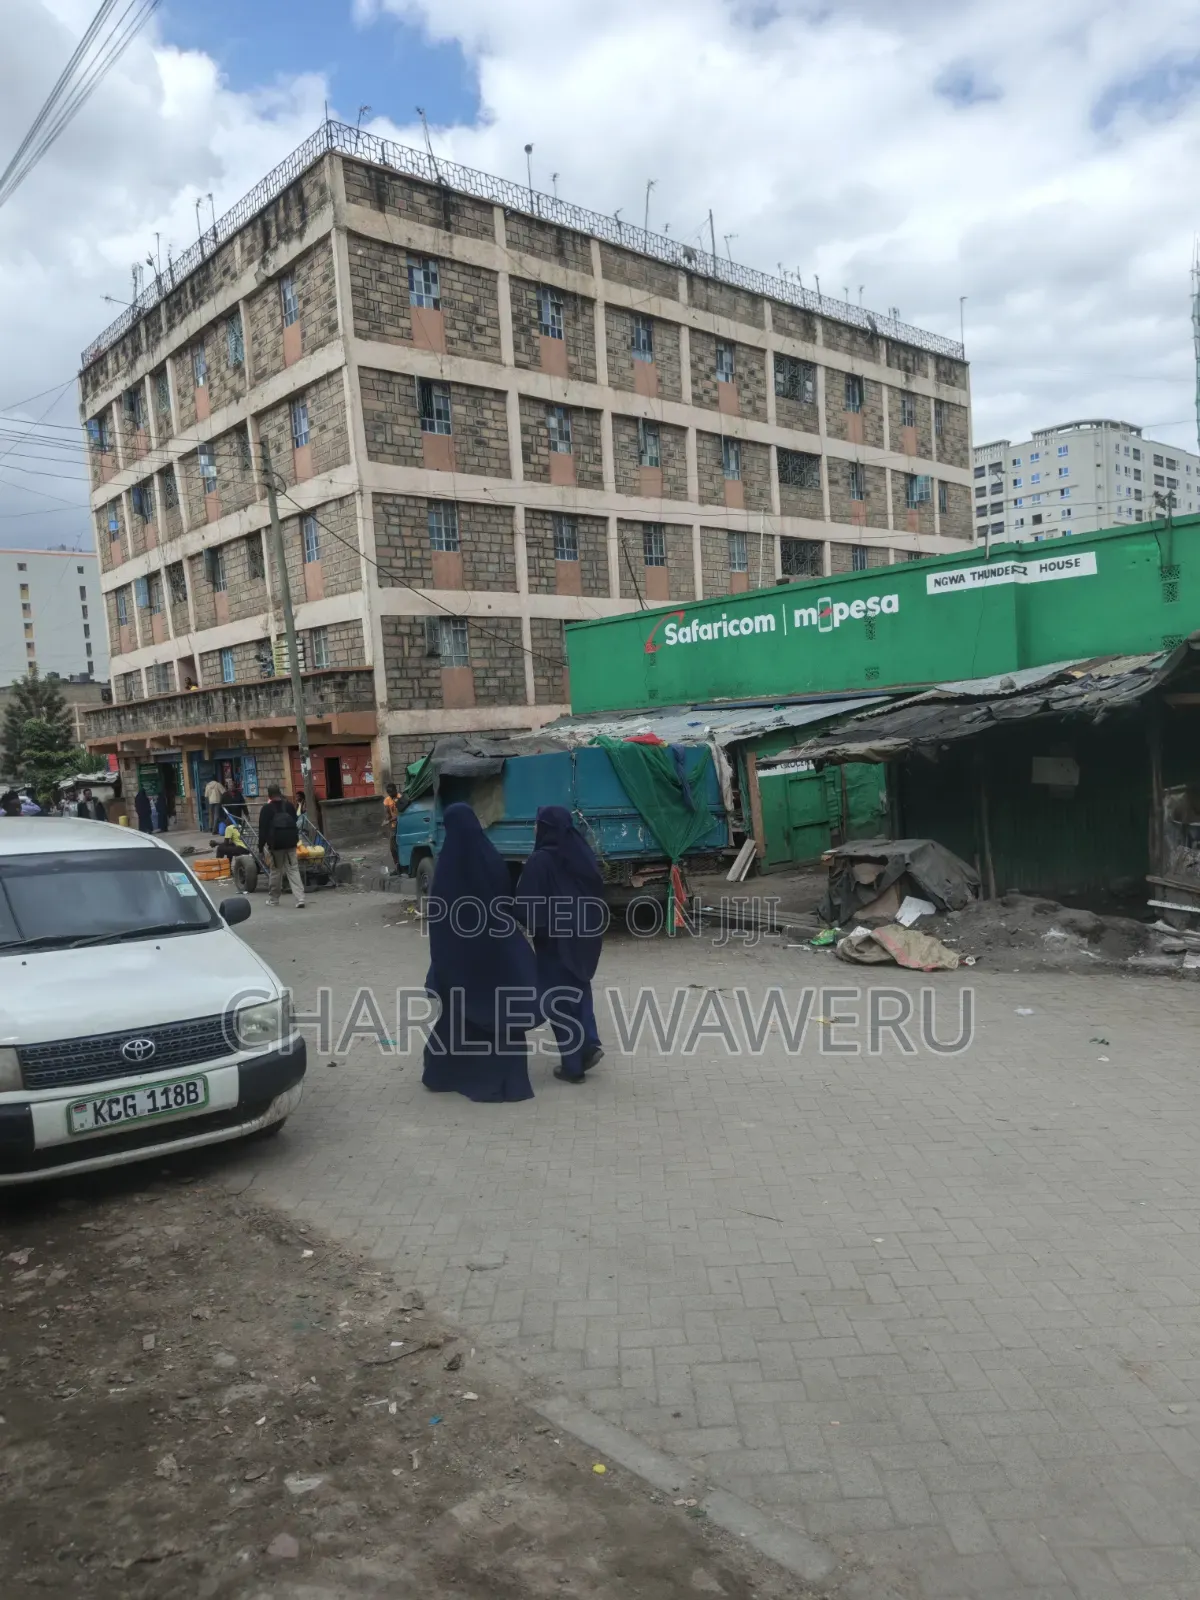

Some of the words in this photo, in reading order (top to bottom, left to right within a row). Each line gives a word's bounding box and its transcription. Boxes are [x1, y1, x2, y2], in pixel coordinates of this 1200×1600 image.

[933, 574, 966, 588] NGWA
[970, 564, 1029, 582] THUNDER
[1039, 557, 1081, 574] HOUSE
[664, 612, 776, 646] Safaricom
[92, 1094, 137, 1125] KCG
[146, 1081, 200, 1113] 118B
